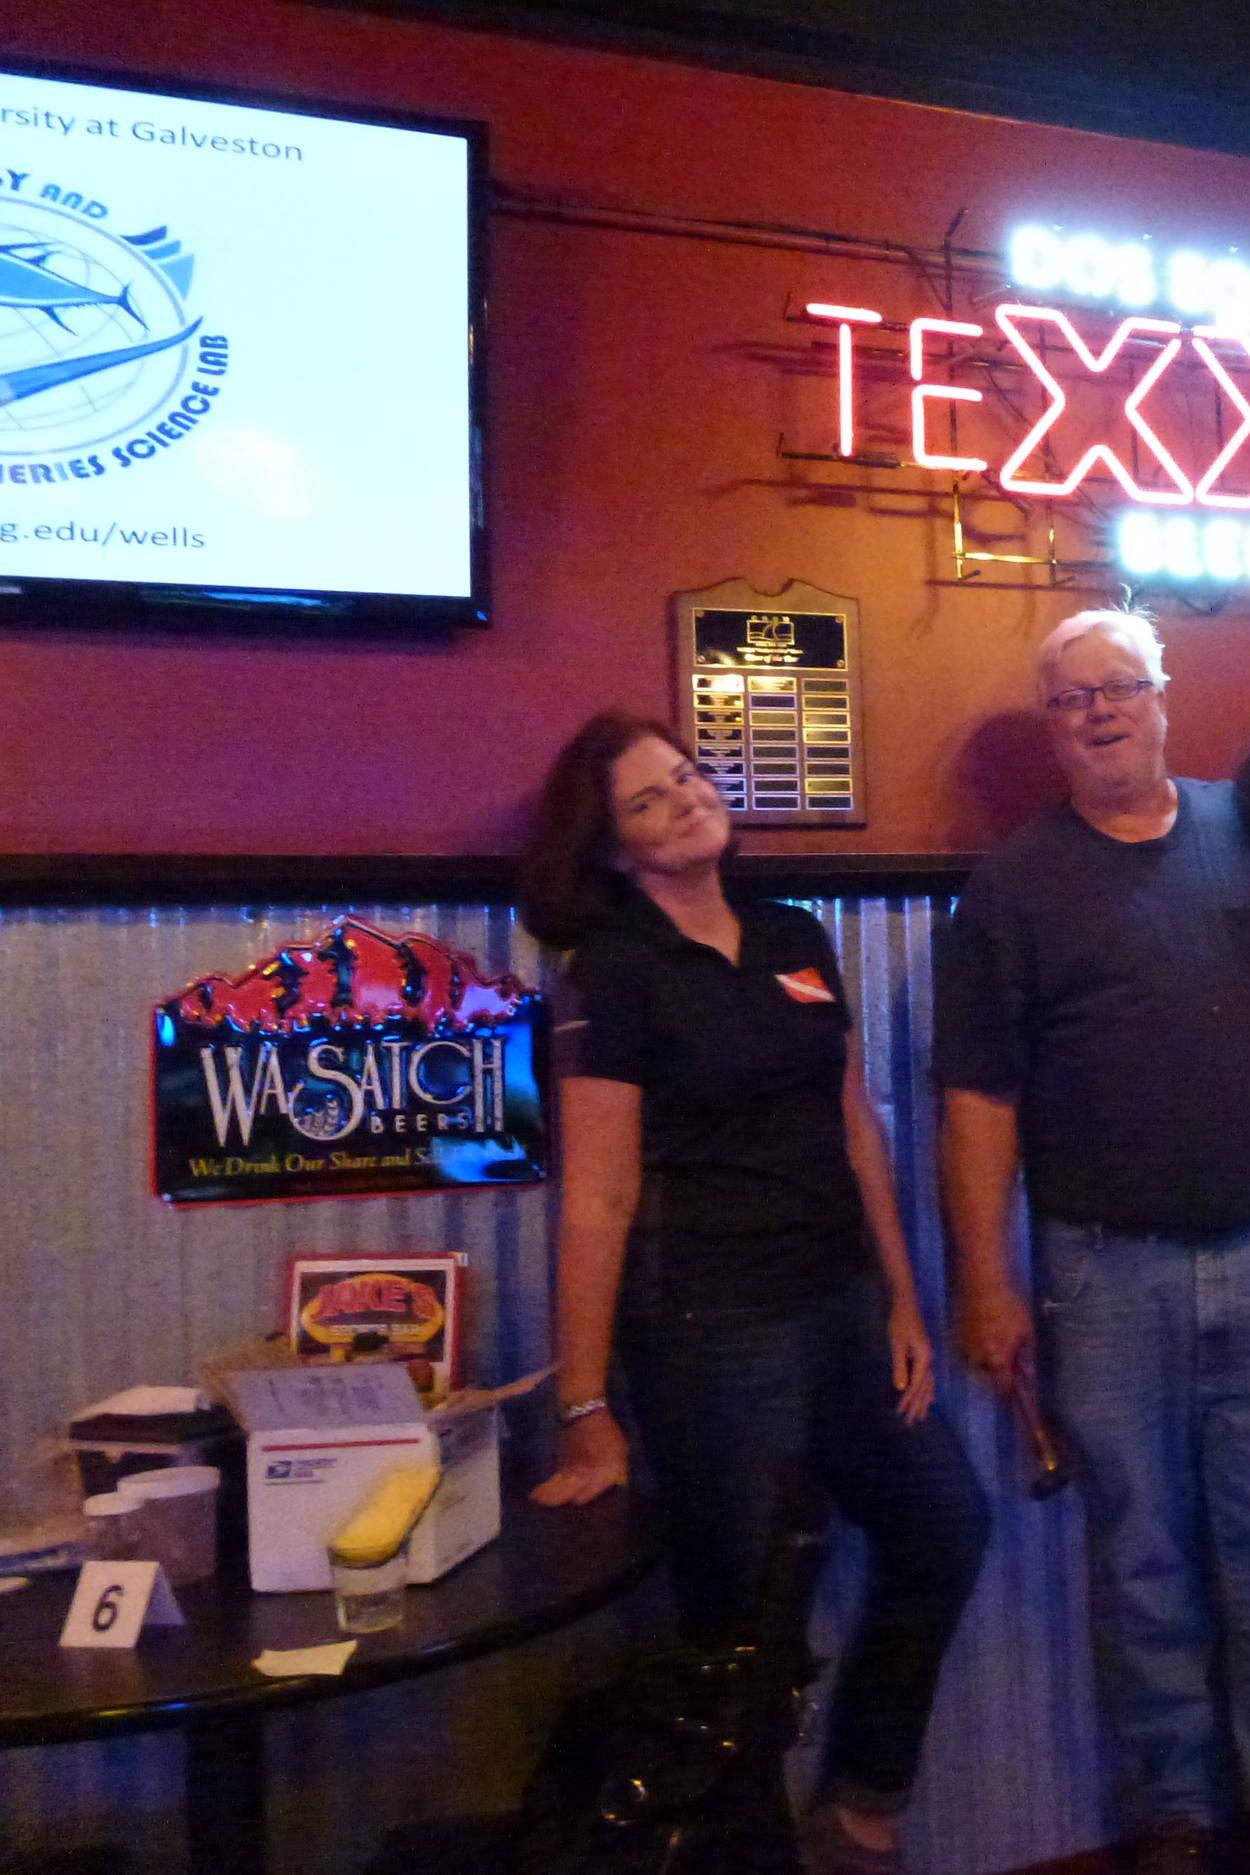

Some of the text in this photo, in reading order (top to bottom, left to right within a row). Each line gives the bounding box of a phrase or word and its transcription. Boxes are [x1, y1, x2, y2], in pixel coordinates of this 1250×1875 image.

[86, 118, 119, 139] at
[132, 121, 304, 162] Galveston
[0, 168, 109, 219] Y AND
[112, 380, 220, 469] SCIENCE
[196, 334, 229, 377] LAB
[0, 521, 206, 550] g.edu/wells
[201, 1038, 505, 1148] WASATCH
[370, 1113, 470, 1135] BEERS
[285, 1152, 326, 1173] Our
[92, 1584, 125, 1633] 6
